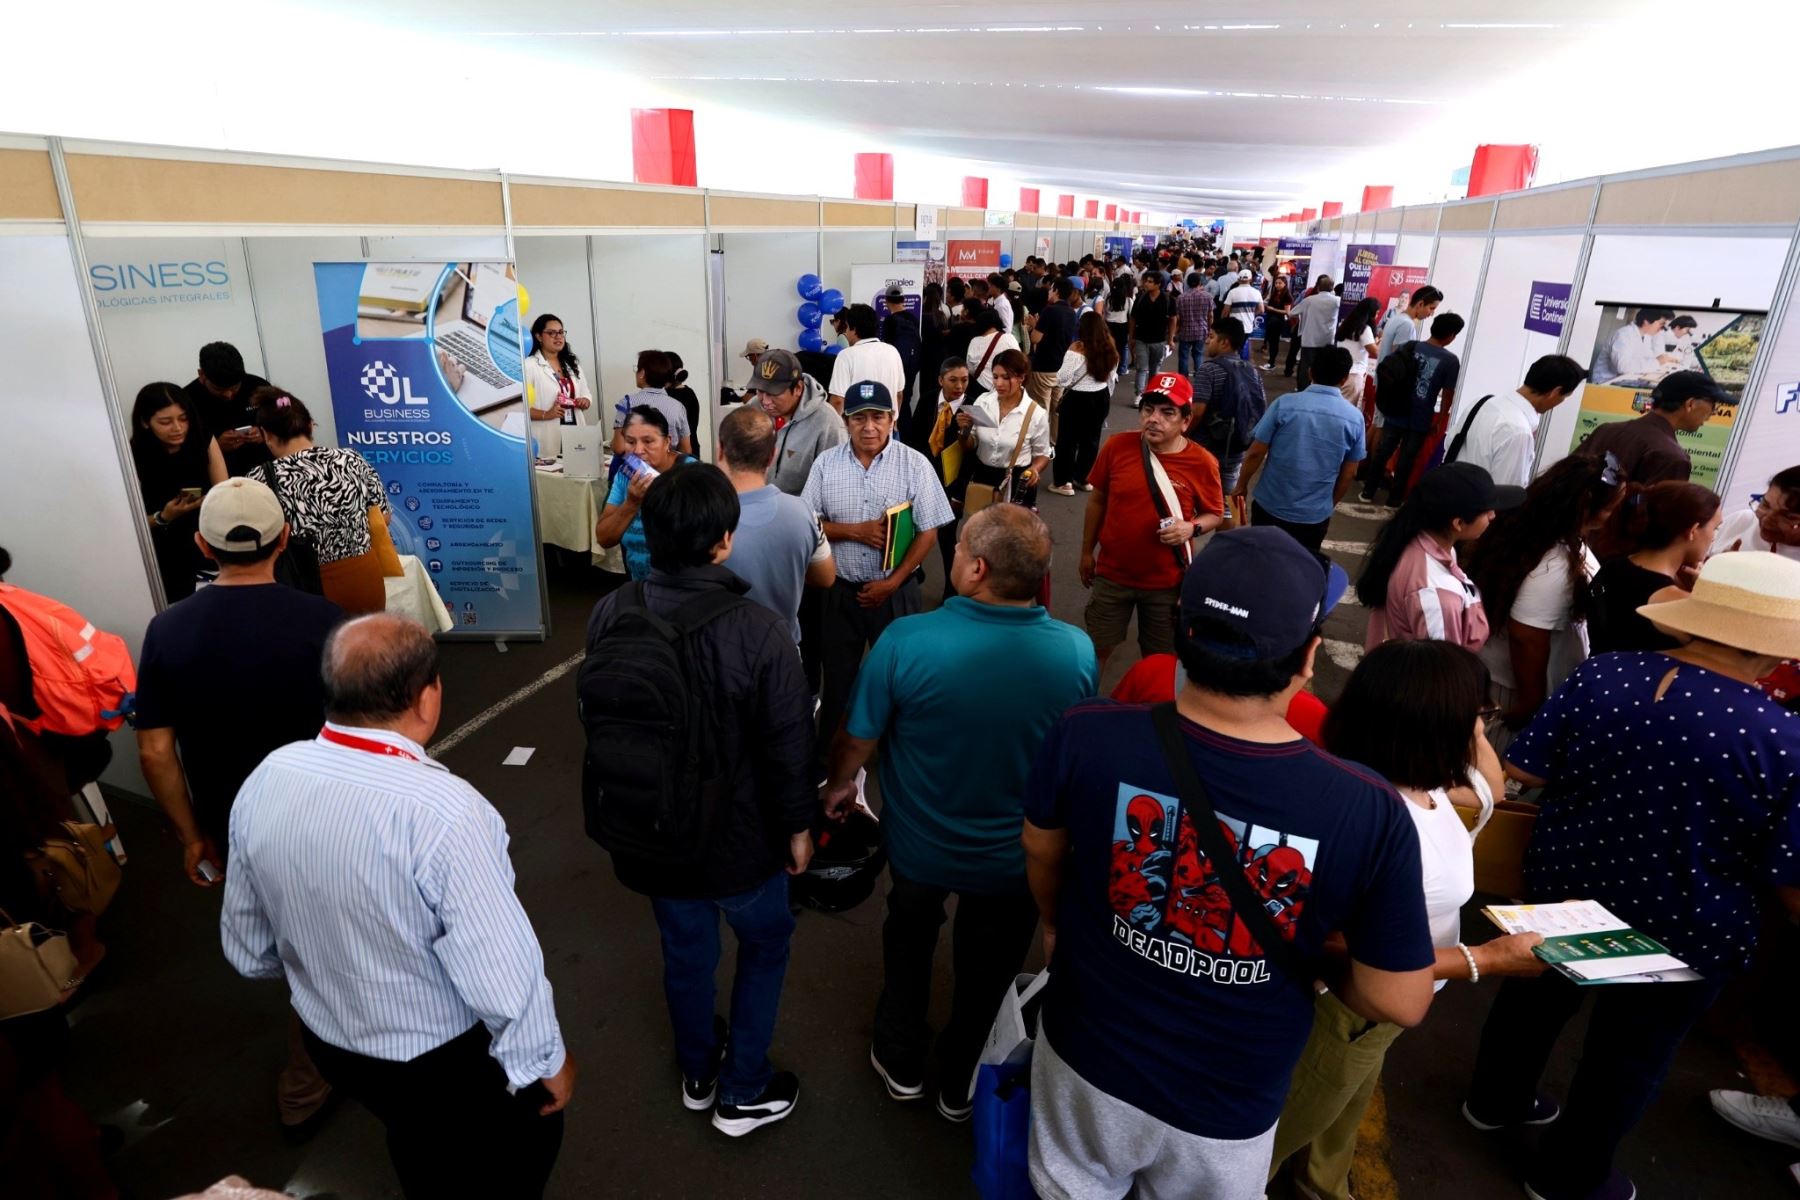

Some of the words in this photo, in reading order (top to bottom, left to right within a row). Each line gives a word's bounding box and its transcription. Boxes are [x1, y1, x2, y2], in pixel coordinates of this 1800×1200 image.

[160, 291, 230, 304] INTEGRALES
[364, 409, 431, 419] BUSINESS
[347, 431, 452, 445] NUESTROS
[364, 450, 453, 464] ERVICIOS
[1204, 597, 1249, 618] SPIDER-MAN
[1113, 914, 1271, 984] DEADPOOL
